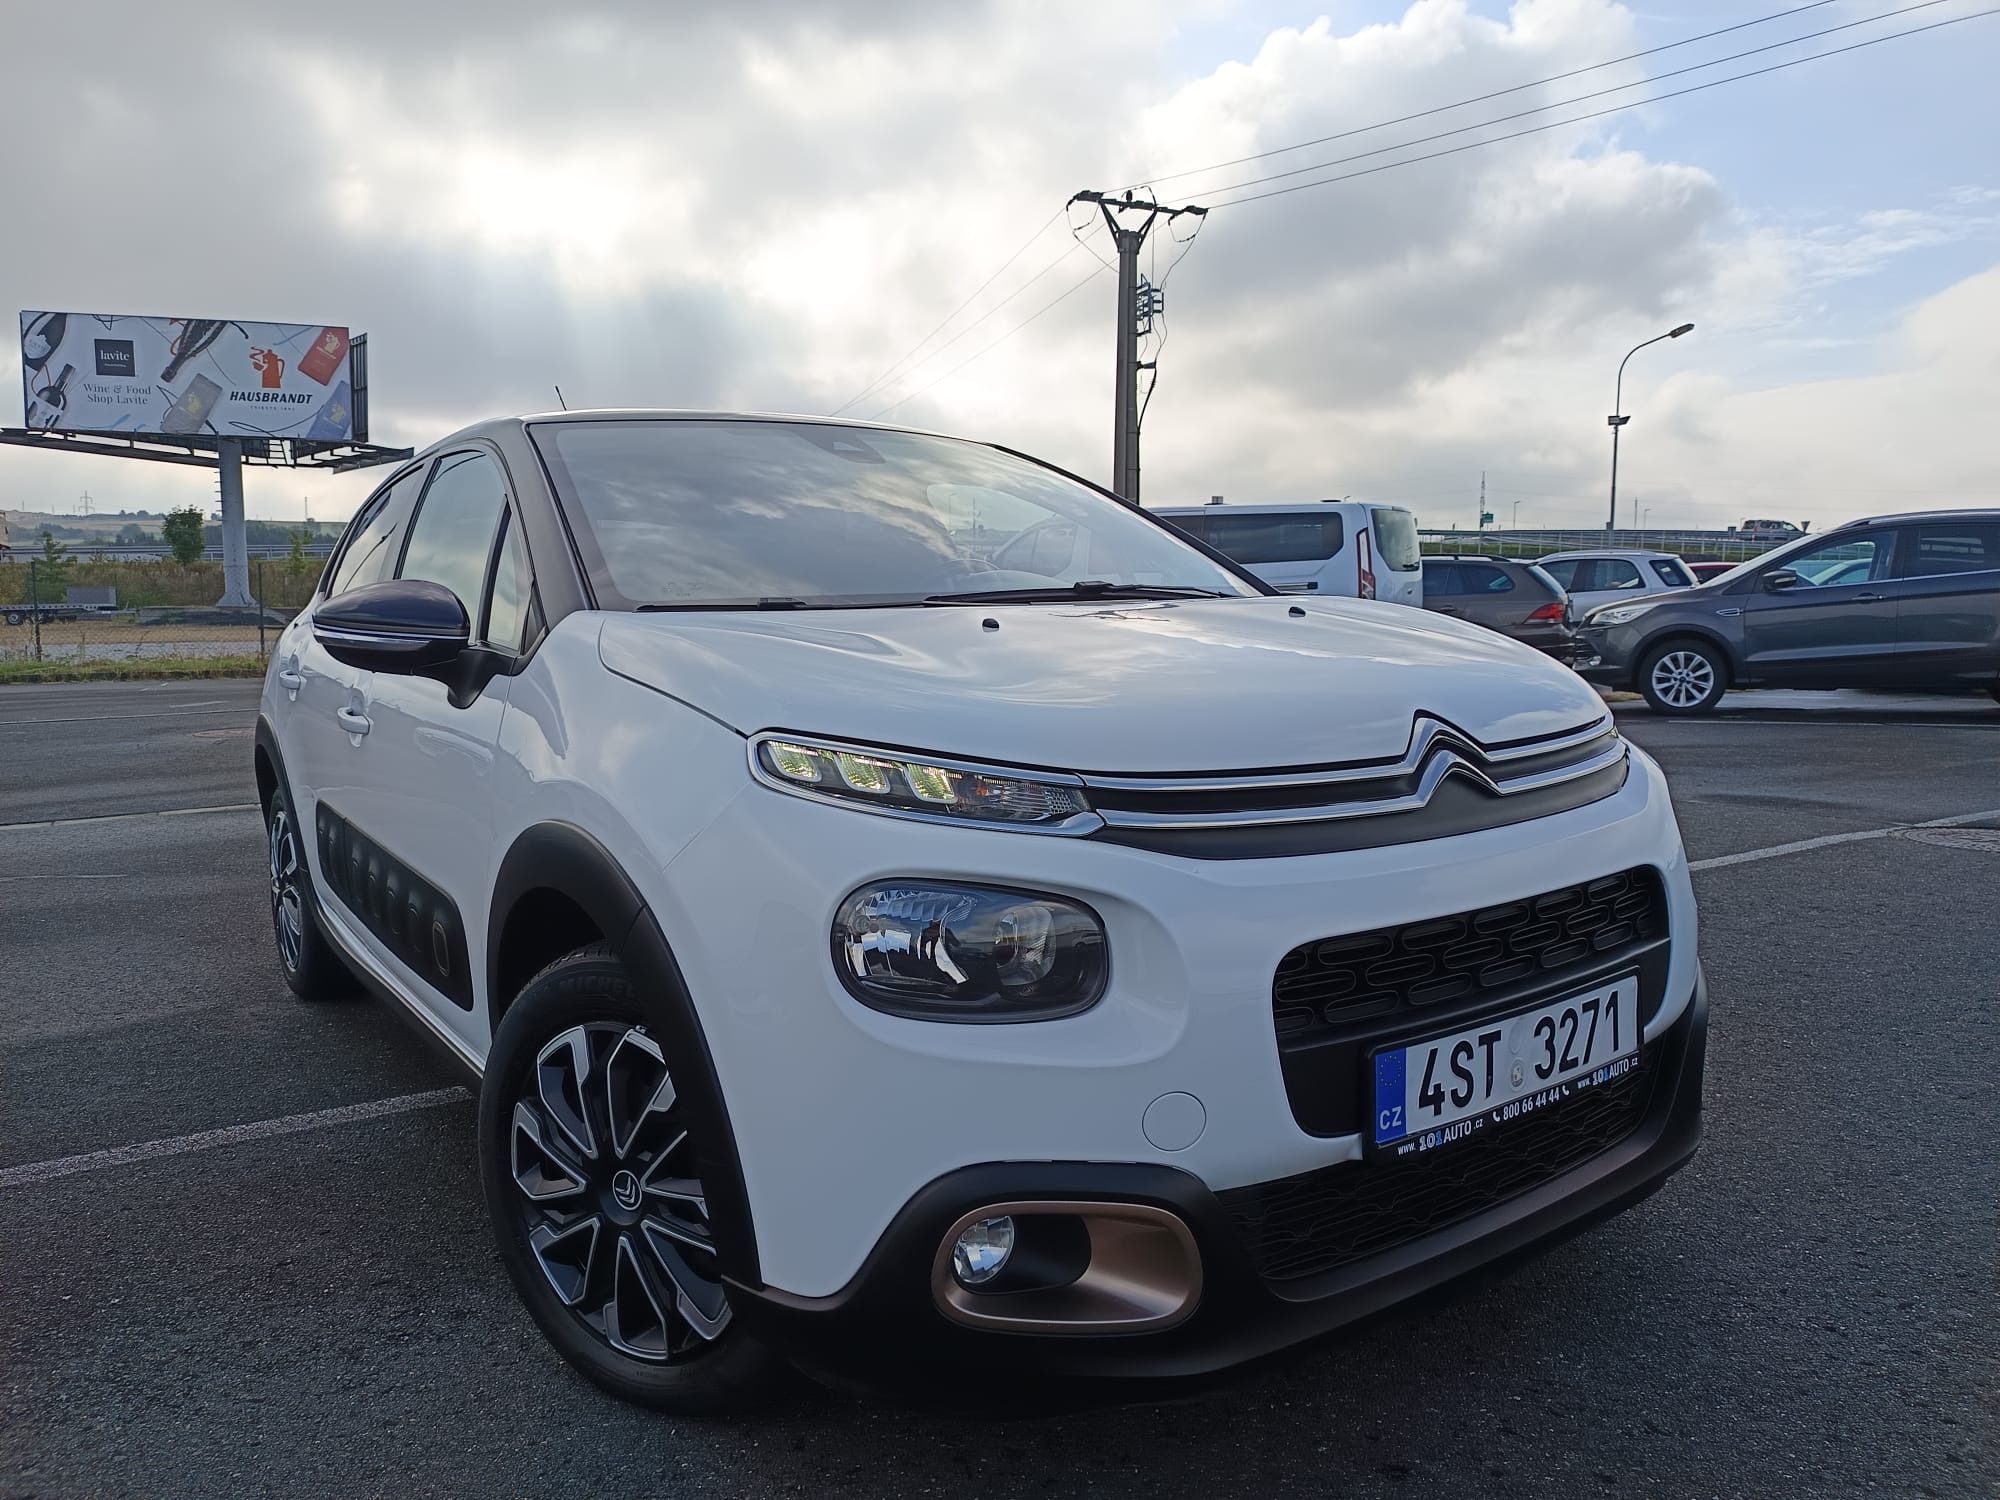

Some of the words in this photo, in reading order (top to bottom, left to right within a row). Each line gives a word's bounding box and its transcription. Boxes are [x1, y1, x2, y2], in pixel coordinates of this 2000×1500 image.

[100, 350, 130, 361] lavite
[83, 384, 109, 393] Wine
[113, 385, 122, 393] &
[126, 385, 151, 395] Food
[87, 394, 113, 404] Shop
[117, 394, 148, 405] Lavite
[230, 391, 313, 404] HAUSBRANDT
[1419, 1029, 1502, 1117] 4ST
[1533, 990, 1620, 1080] 3271
[1503, 1104, 1520, 1121] 800
[1522, 1097, 1534, 1113] 66
[1535, 1091, 1547, 1108] 44
[1549, 1086, 1561, 1103] 44
[1379, 1106, 1402, 1130] CZ
